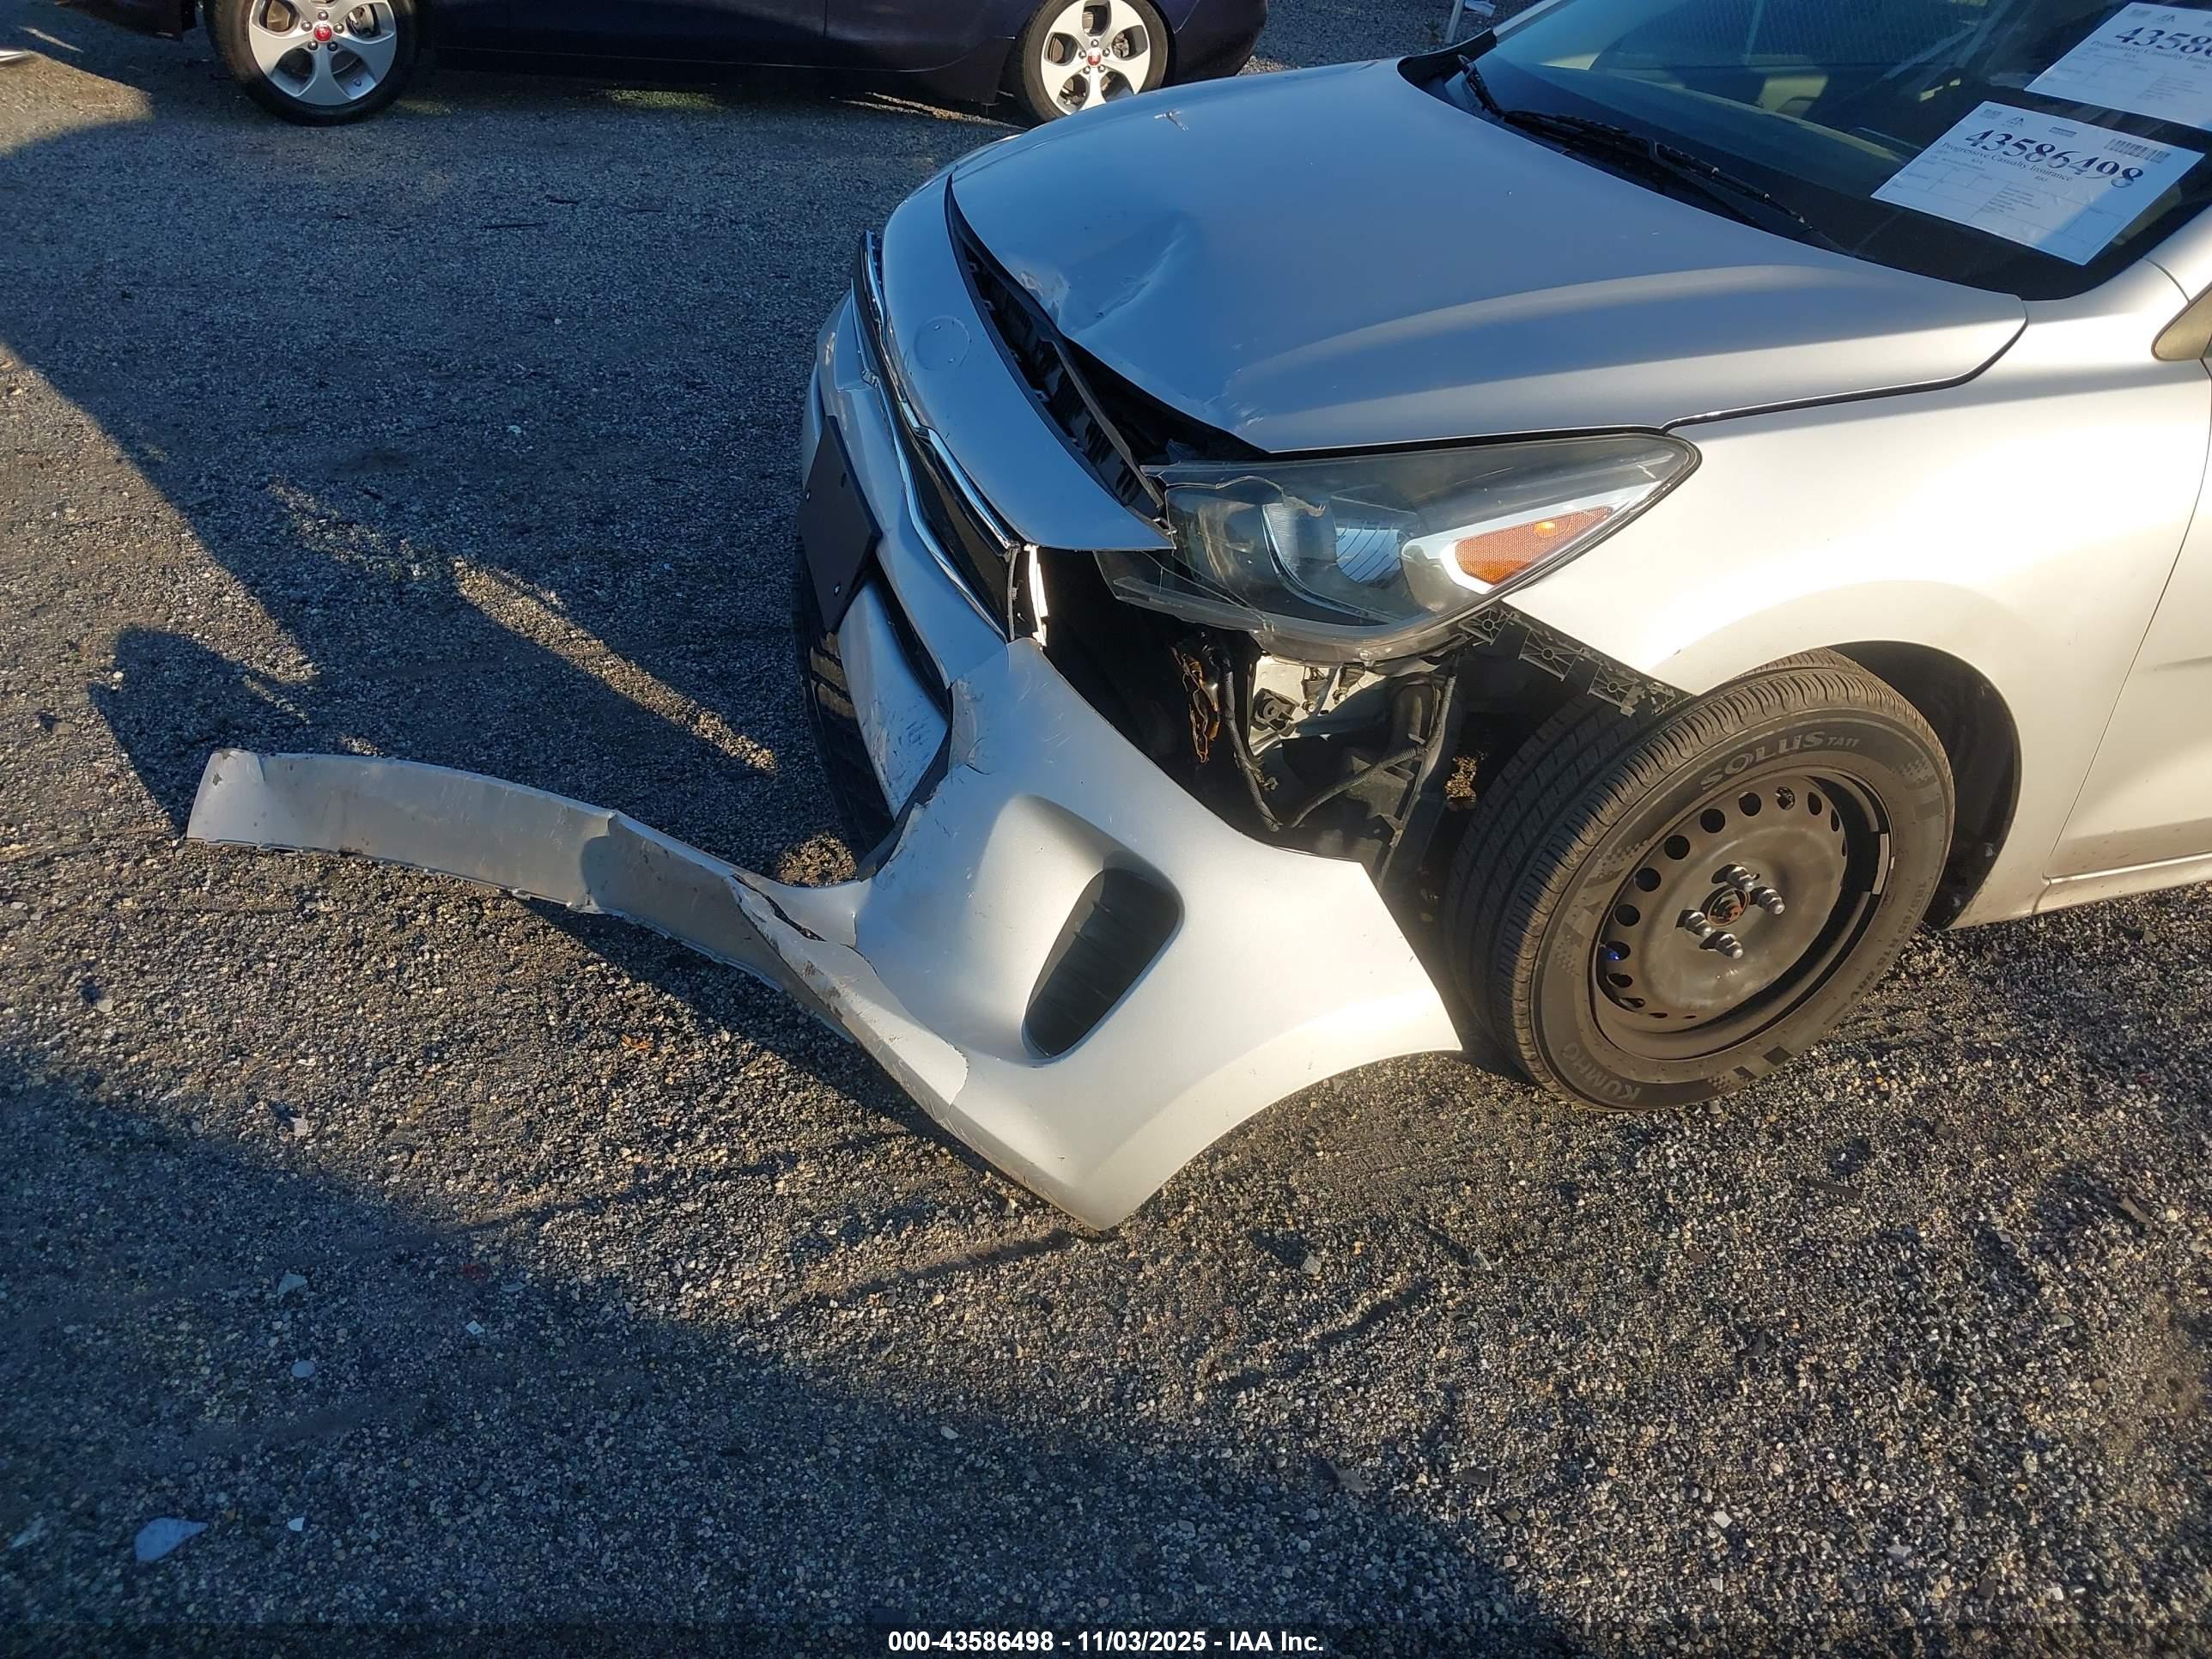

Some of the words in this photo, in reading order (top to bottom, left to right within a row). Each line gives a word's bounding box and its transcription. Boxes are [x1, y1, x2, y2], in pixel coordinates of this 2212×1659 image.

[1942, 143, 1991, 159] Progressive
[1991, 155, 2029, 169] Casualty
[2029, 164, 2074, 182] Insurance
[1964, 130, 2144, 188] 43586498
[1700, 731, 1826, 791] SOLUS
[1561, 1042, 1642, 1102] KUMHO
